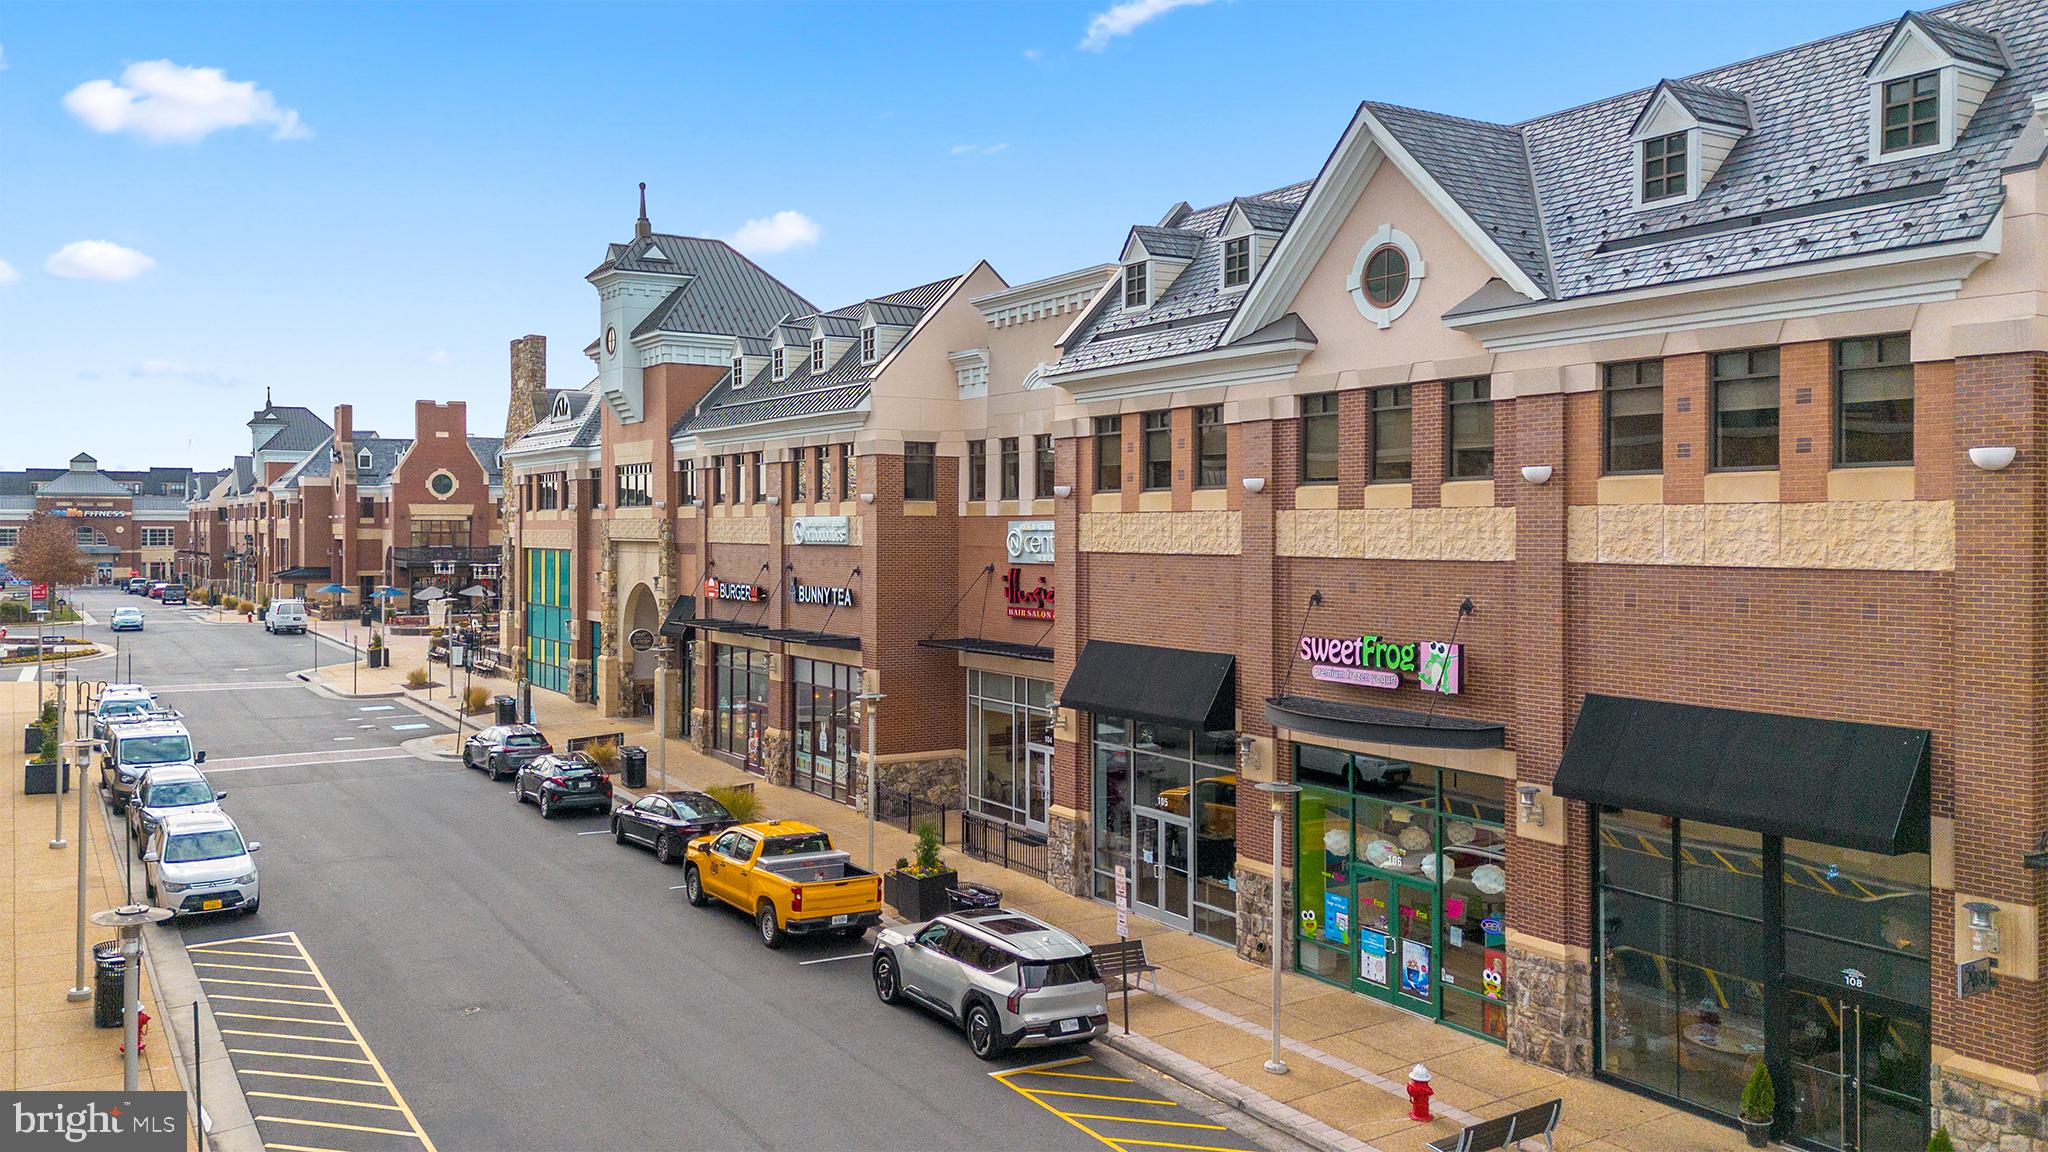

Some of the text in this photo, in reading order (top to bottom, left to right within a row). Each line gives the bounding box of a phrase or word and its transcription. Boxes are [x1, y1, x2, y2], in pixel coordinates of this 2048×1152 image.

[83, 510, 125, 518] FITNESS
[799, 585, 852, 606] BUNNY TEA
[1008, 608, 1052, 618] HAIR SALON
[1300, 634, 1415, 671] sweetFrog
[1313, 666, 1396, 686] premium frozen yogurt
[1157, 796, 1169, 807] 105
[1387, 854, 1402, 867] 106
[1845, 976, 1863, 988] 108
